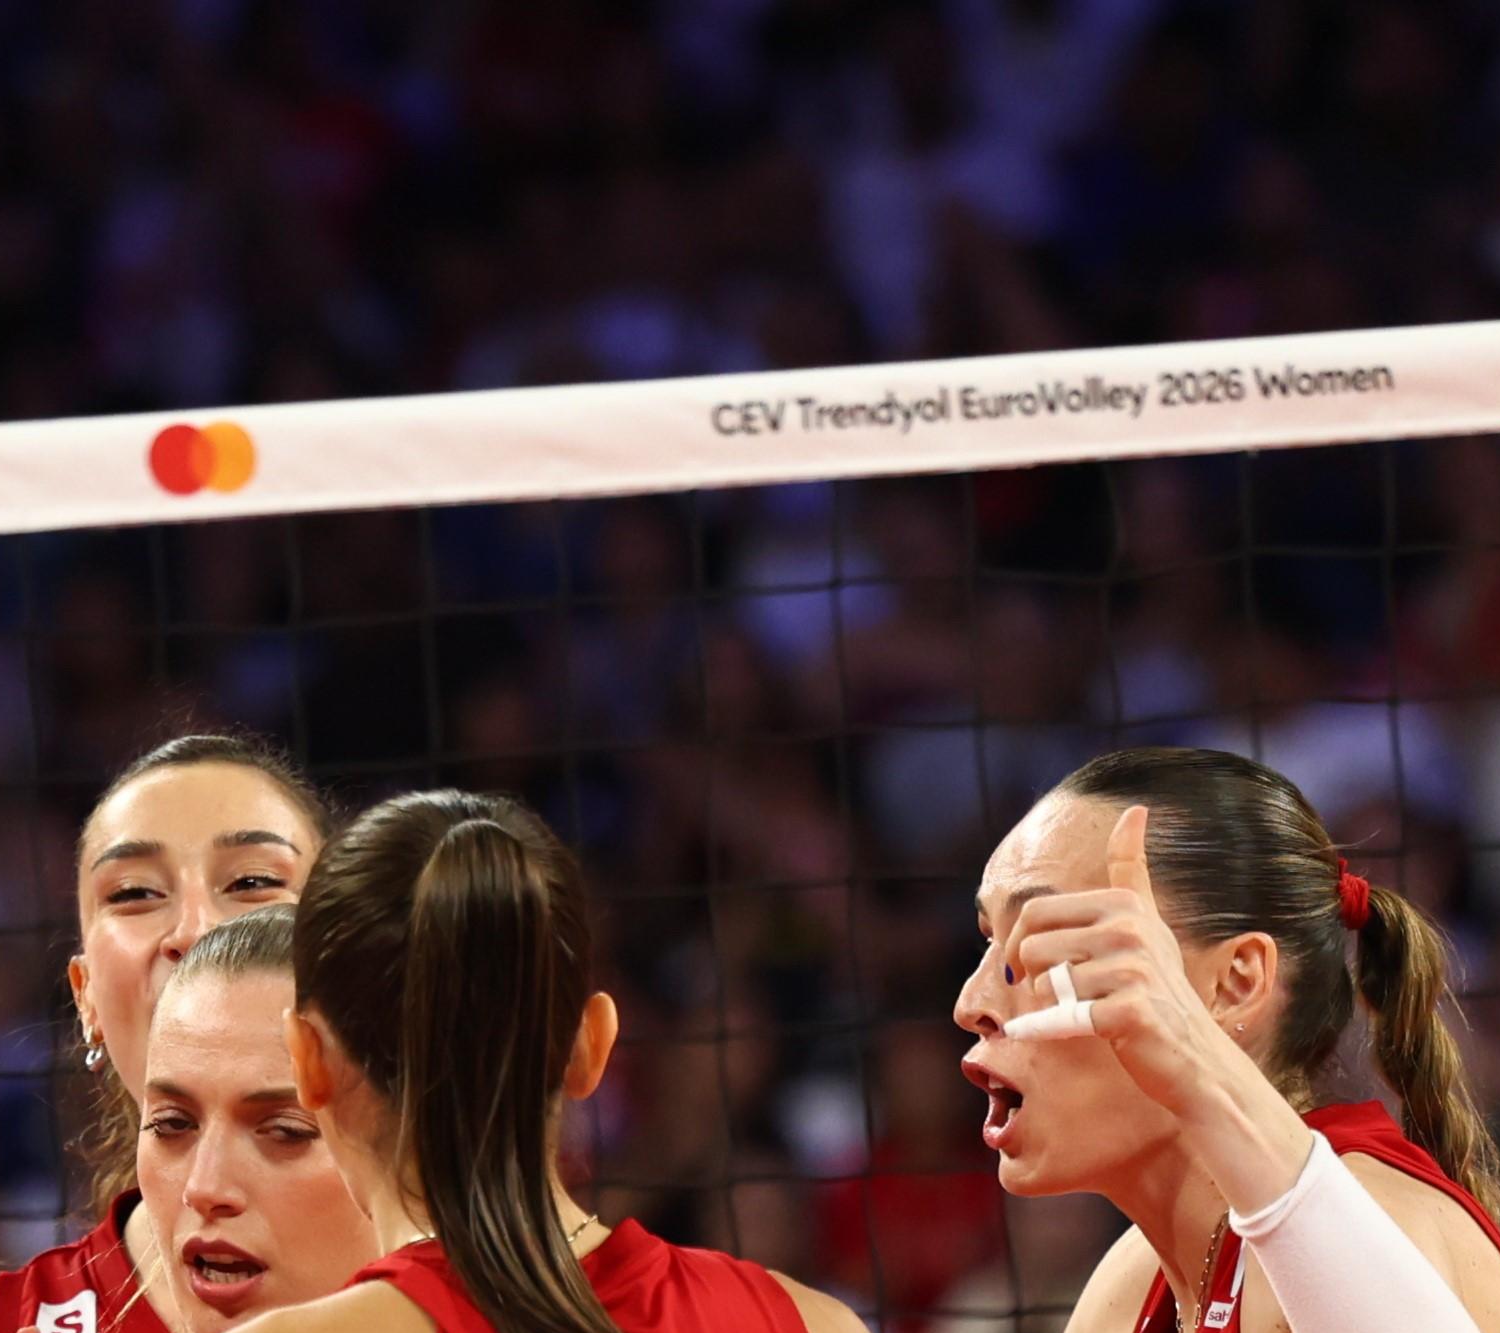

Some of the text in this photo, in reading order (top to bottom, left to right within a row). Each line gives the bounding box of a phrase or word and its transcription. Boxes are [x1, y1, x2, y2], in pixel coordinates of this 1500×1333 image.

[711, 362, 1396, 437] CEV Trendyol EuroVolley 2026 Women
